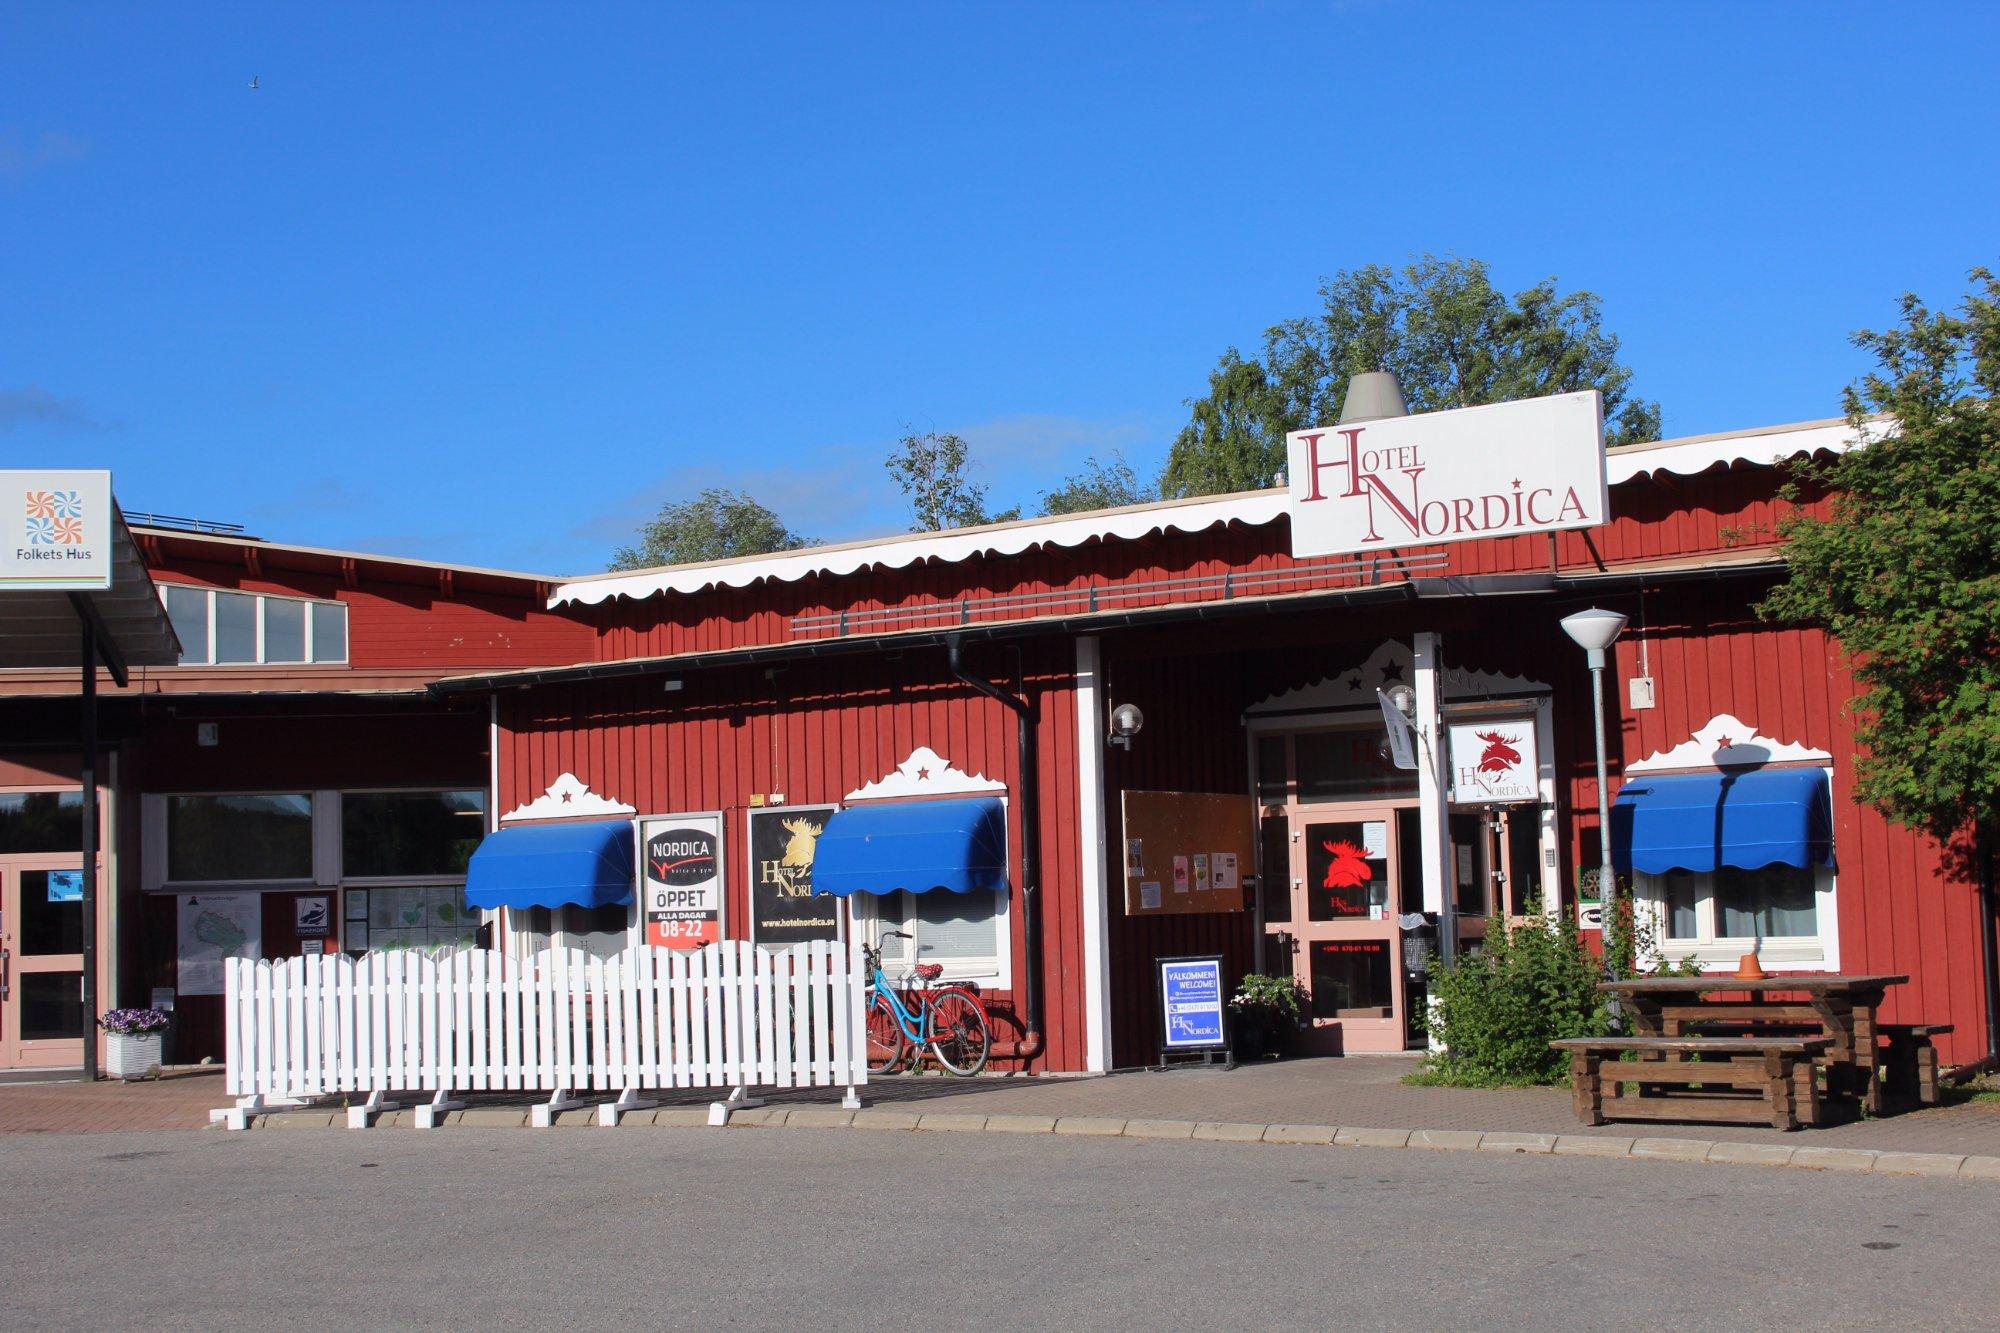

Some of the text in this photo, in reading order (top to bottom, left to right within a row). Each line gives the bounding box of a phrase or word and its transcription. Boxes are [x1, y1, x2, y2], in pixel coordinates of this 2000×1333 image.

[16, 548, 92, 560] Folkets Hus
[653, 841, 710, 858] NORDICA
[656, 889, 706, 908] ÖPPET
[657, 911, 707, 920] ALLA DAGAR
[659, 920, 703, 937] 08-22
[761, 917, 836, 928] www.hotelnordica.se
[1179, 980, 1216, 989] WELCOME!
